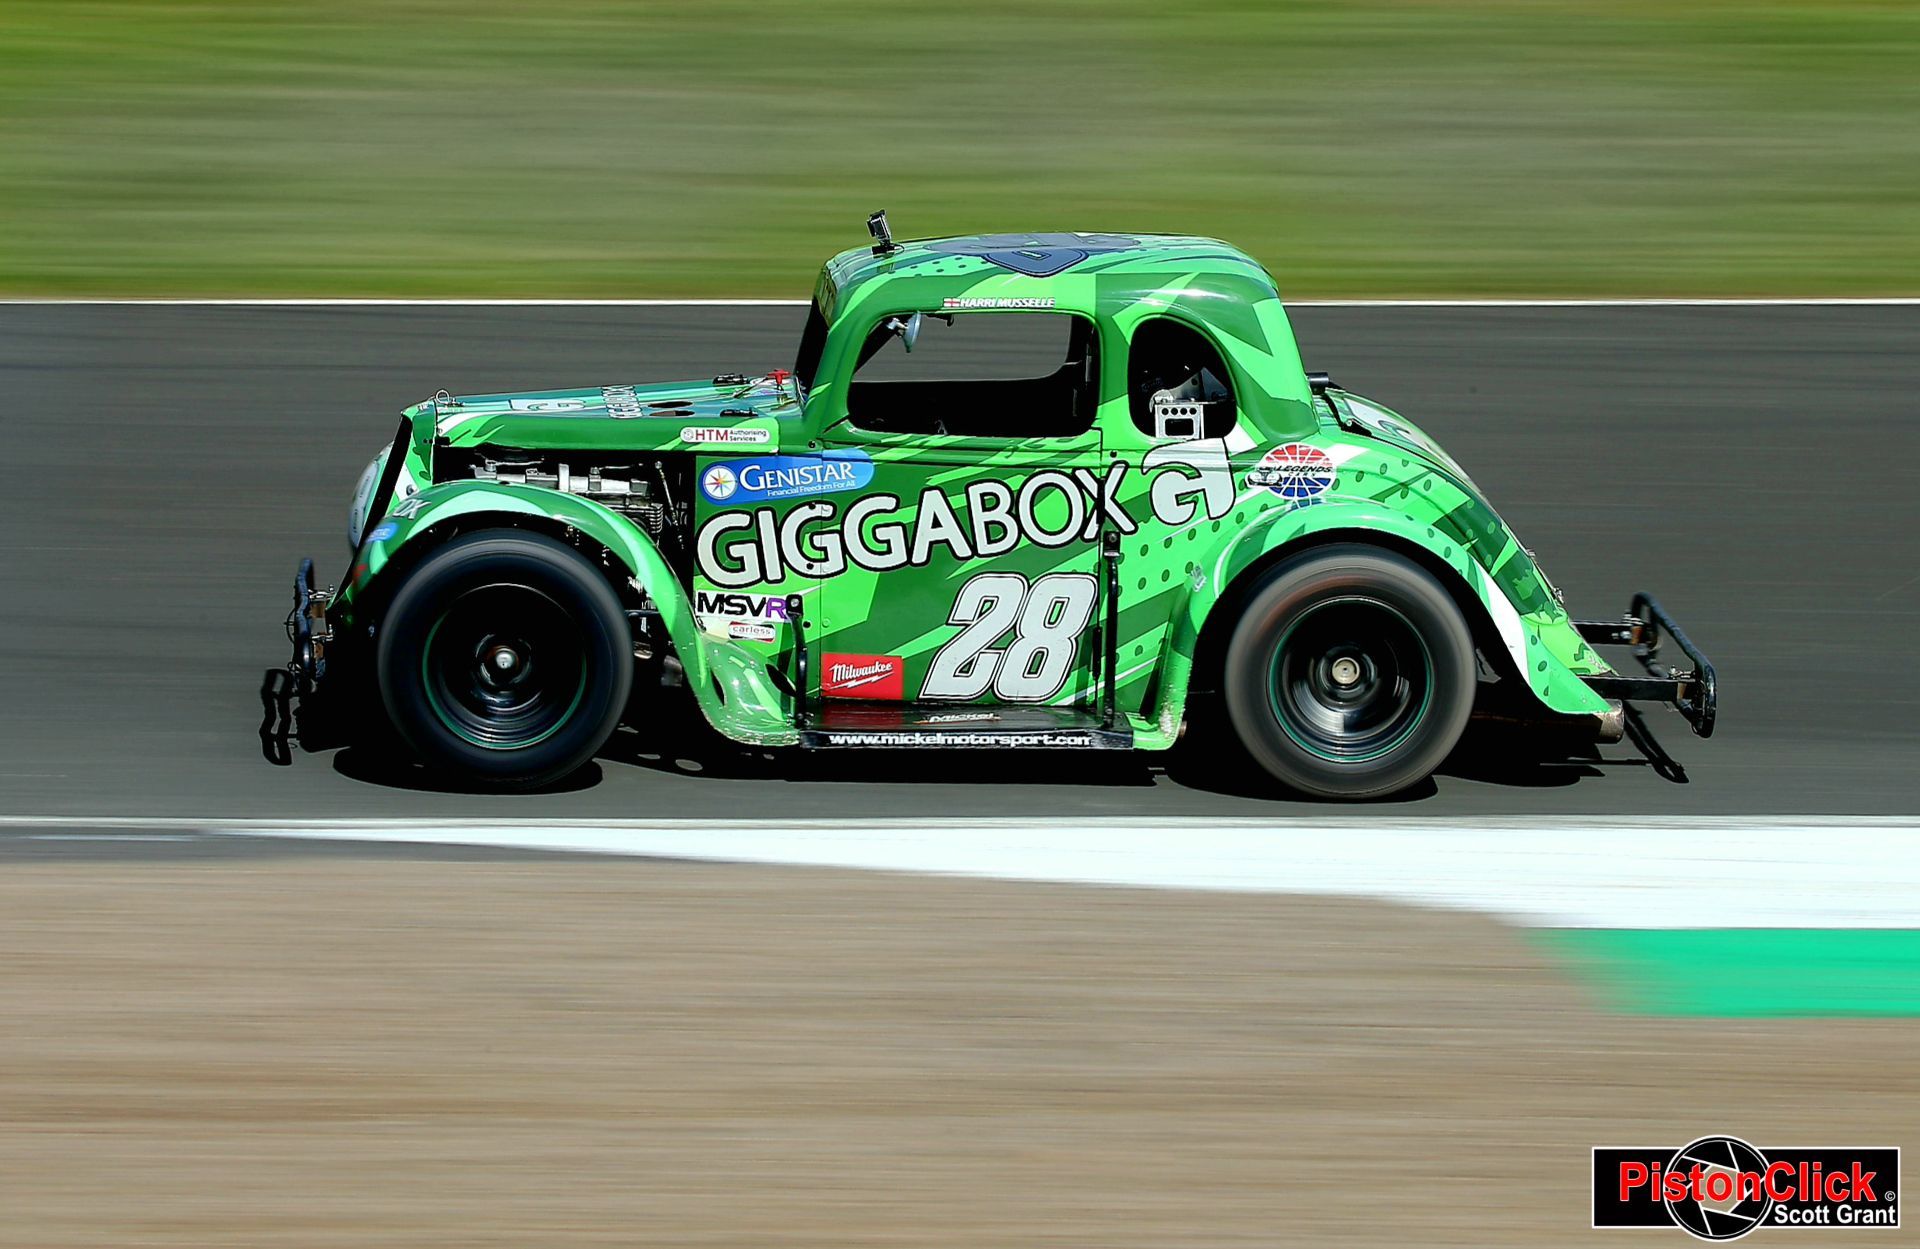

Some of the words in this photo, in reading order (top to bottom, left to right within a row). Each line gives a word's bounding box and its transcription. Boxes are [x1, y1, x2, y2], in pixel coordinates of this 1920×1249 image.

[695, 429, 728, 441] HTM
[767, 487, 799, 497] Financial
[800, 483, 833, 493] Freedom
[695, 461, 1138, 590] GIGGABOX
[697, 592, 788, 619] MSVR
[732, 625, 771, 635] carless
[919, 572, 1098, 701] 28
[829, 661, 894, 683] Milwaukee
[829, 732, 1092, 747] www.mickelmotorsport.com
